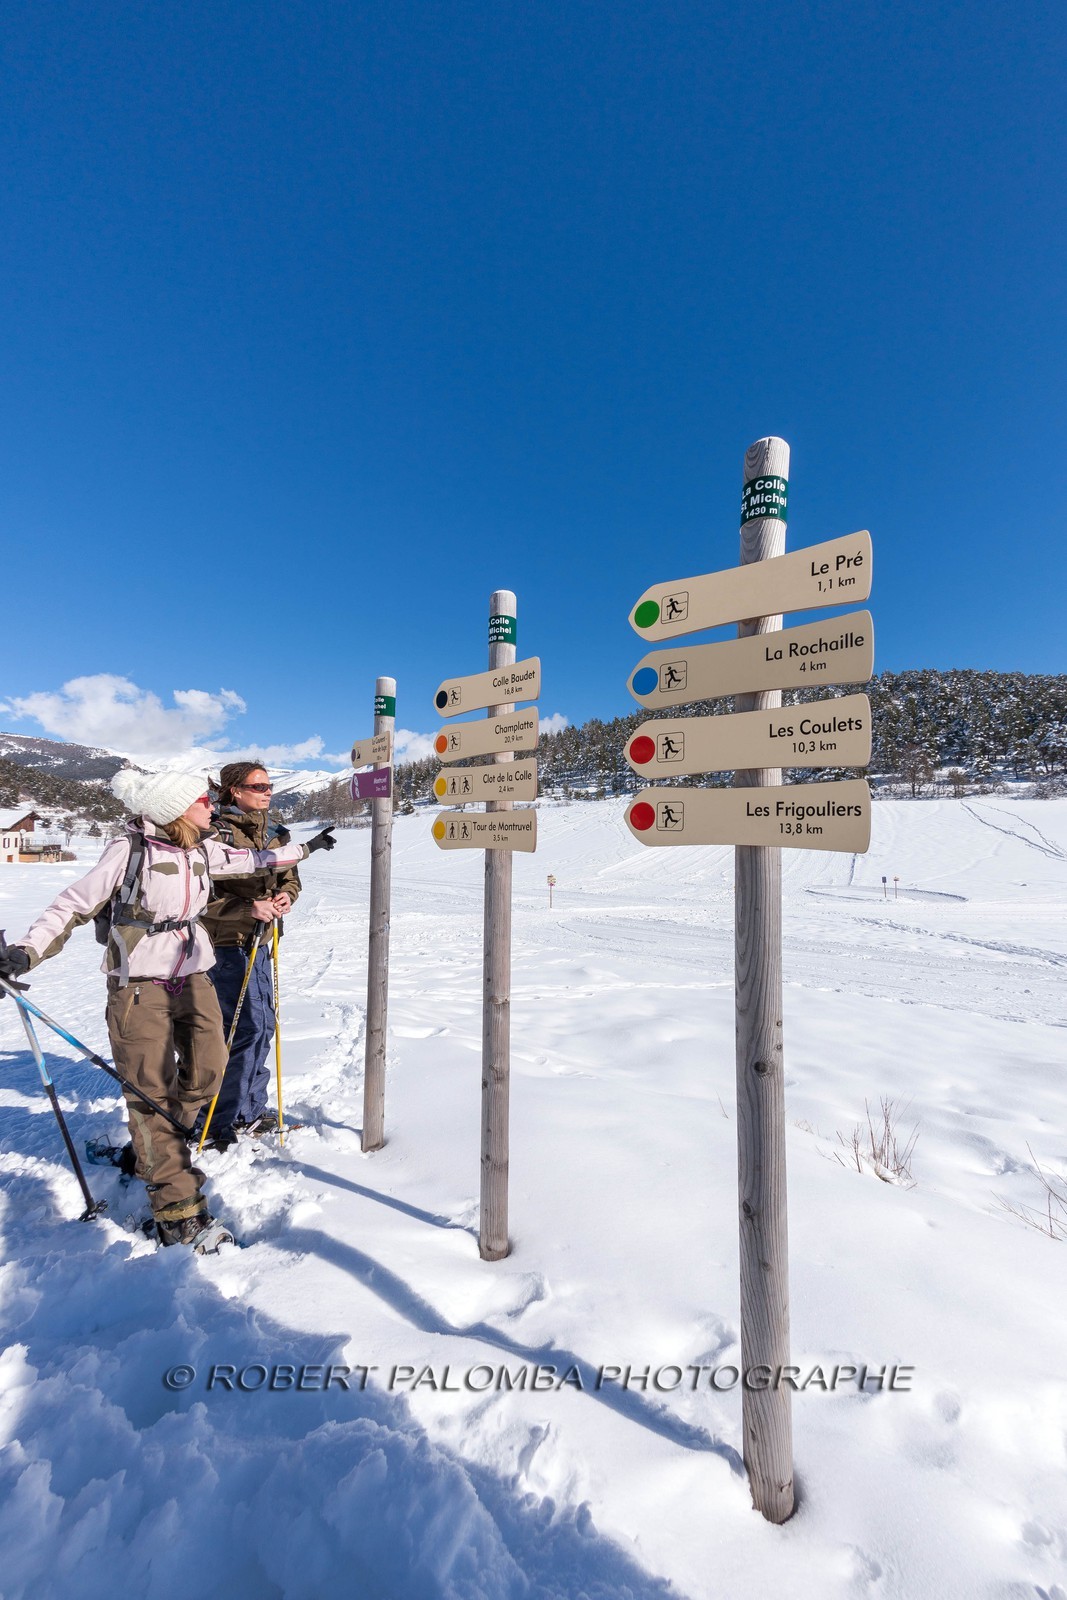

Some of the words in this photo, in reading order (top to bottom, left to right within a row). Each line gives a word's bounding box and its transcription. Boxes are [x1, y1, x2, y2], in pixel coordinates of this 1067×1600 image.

[755, 479, 786, 492] Colle
[750, 493, 787, 508] Michel
[745, 506, 766, 519] 1430
[769, 507, 778, 515] m
[811, 561, 830, 577] Le
[836, 550, 864, 571] Pré
[817, 579, 833, 592] 1,1
[838, 576, 856, 588] km
[490, 617, 510, 626] Colle
[765, 647, 783, 662] La
[789, 632, 865, 658] Rochaille
[799, 662, 806, 672] 4
[810, 661, 827, 672] km
[492, 676, 510, 688] Colle
[511, 670, 536, 684] Baudet
[504, 686, 515, 696] 16,8
[494, 720, 534, 735] Champlatte
[769, 723, 794, 738] Les
[800, 716, 863, 736] Coulets
[792, 741, 816, 754] 10,3
[820, 740, 837, 752] km
[482, 774, 496, 784] Clot
[496, 774, 506, 783] de
[506, 772, 513, 782] la
[514, 770, 532, 781] Colle
[498, 786, 506, 794] 2,4
[746, 802, 770, 818] Les
[776, 800, 862, 820] Frigouliers
[472, 822, 488, 832] Tour
[488, 822, 497, 832] de
[498, 821, 532, 832] Montruvel
[780, 823, 803, 836] 13,8
[806, 824, 823, 835] km
